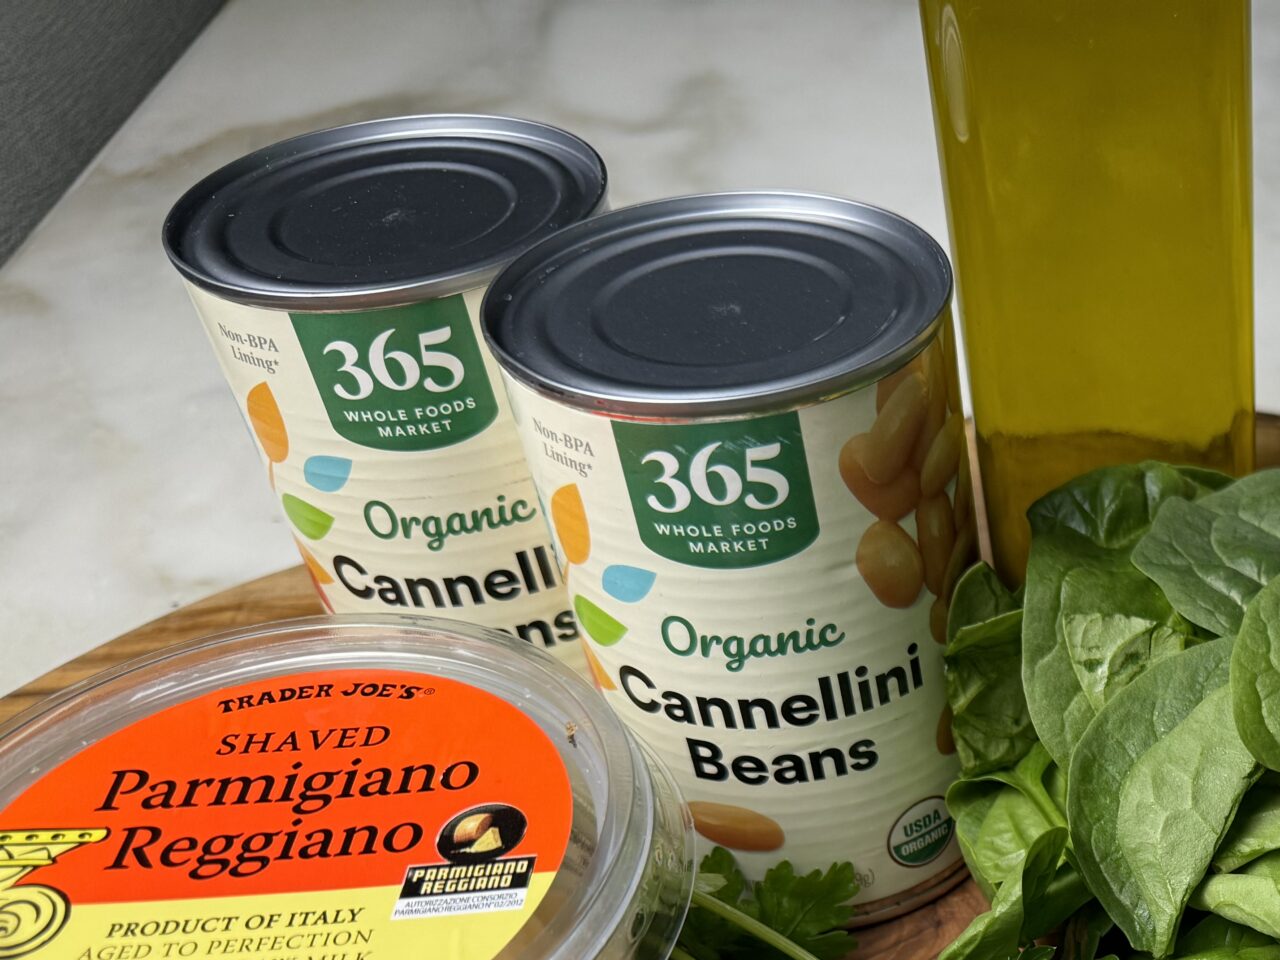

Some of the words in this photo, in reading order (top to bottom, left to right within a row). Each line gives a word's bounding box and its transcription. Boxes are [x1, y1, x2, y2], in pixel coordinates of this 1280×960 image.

[217, 321, 279, 352] Non-BPA
[323, 325, 465, 400] 365
[343, 410, 409, 423] WHOLE
[415, 397, 476, 420] FOODS
[378, 419, 452, 438] MARKET
[531, 415, 595, 457] Non-BPA
[641, 441, 790, 513] 365
[363, 494, 537, 552] Organic
[653, 522, 723, 537] WHOLE
[731, 517, 797, 536] FOODS
[688, 538, 769, 553] MARKET
[660, 616, 846, 673] Organic
[217, 684, 334, 714] TRADER
[618, 643, 924, 730] Cannellini
[215, 725, 391, 756] SHAVED
[685, 737, 879, 786] Beans
[95, 757, 479, 815] Parmigiano
[903, 809, 942, 838] USDA
[104, 817, 423, 880] Reggiano
[900, 823, 948, 856] ORGANIC
[412, 859, 529, 883] PARMIGIANO
[420, 874, 513, 895] REGGIANO
[105, 916, 238, 939] PRODUCT
[244, 913, 281, 930] OF
[285, 907, 366, 929] ITALY
[162, 941, 198, 959] TO
[205, 928, 375, 956] PERFECTION
